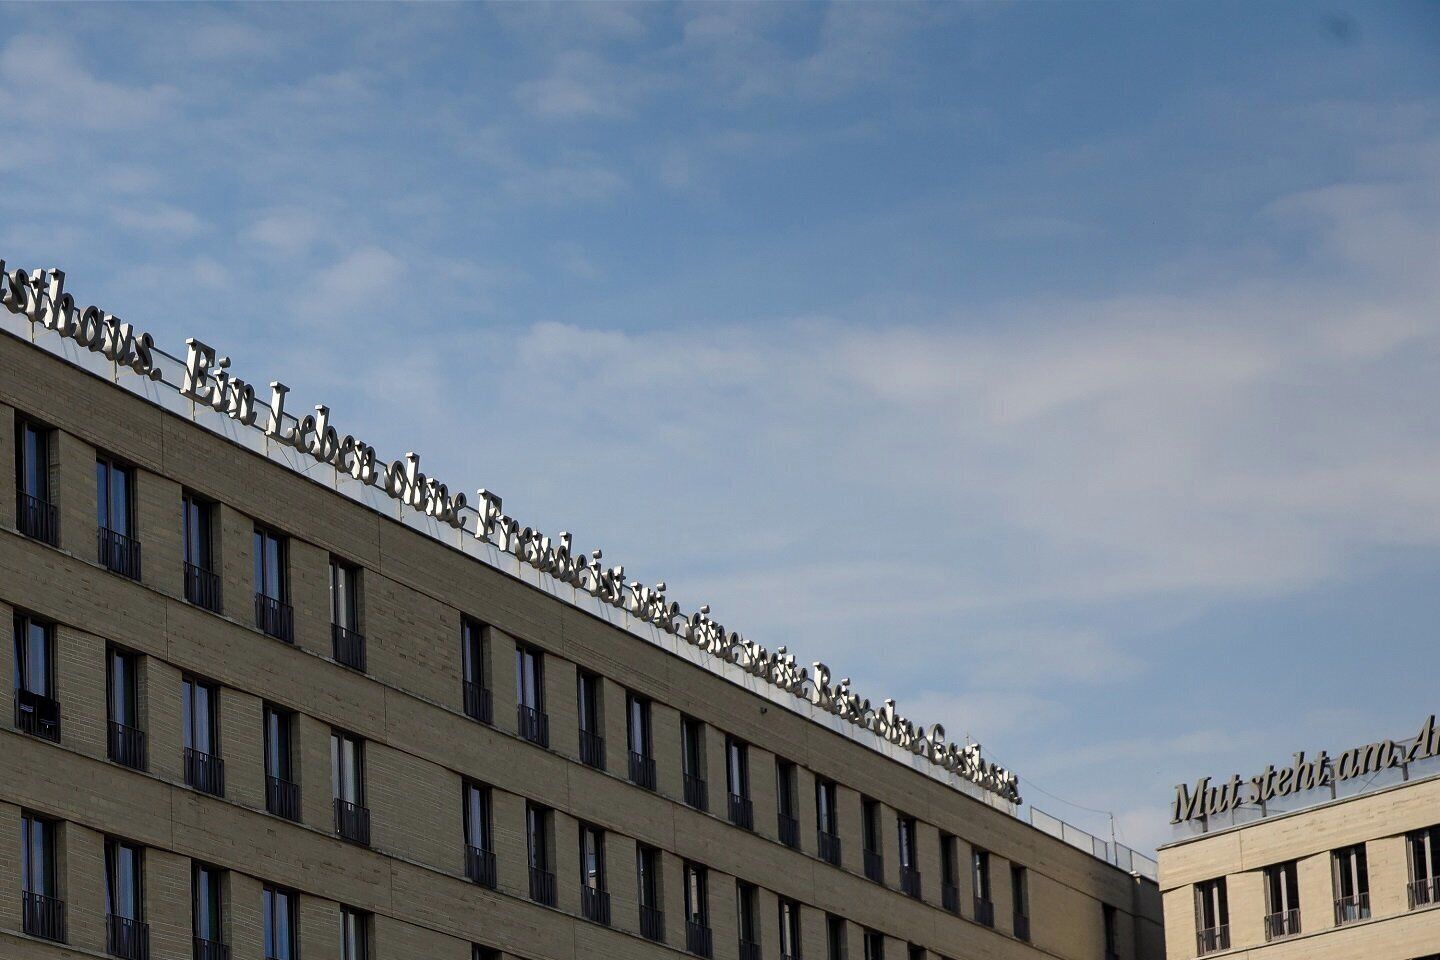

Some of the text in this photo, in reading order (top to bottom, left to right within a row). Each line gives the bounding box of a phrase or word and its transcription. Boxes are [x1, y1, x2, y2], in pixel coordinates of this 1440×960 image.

[179, 337, 257, 425] Ein
[264, 381, 378, 485] Leben
[383, 451, 467, 529] ohne
[474, 488, 587, 588] Freude
[588, 549, 626, 608] ist
[630, 581, 679, 634] wie
[684, 604, 739, 664] eine
[812, 661, 872, 728] Reise
[1169, 773, 1243, 825] Mut
[1247, 751, 1331, 805] steht
[1331, 738, 1397, 782] am
